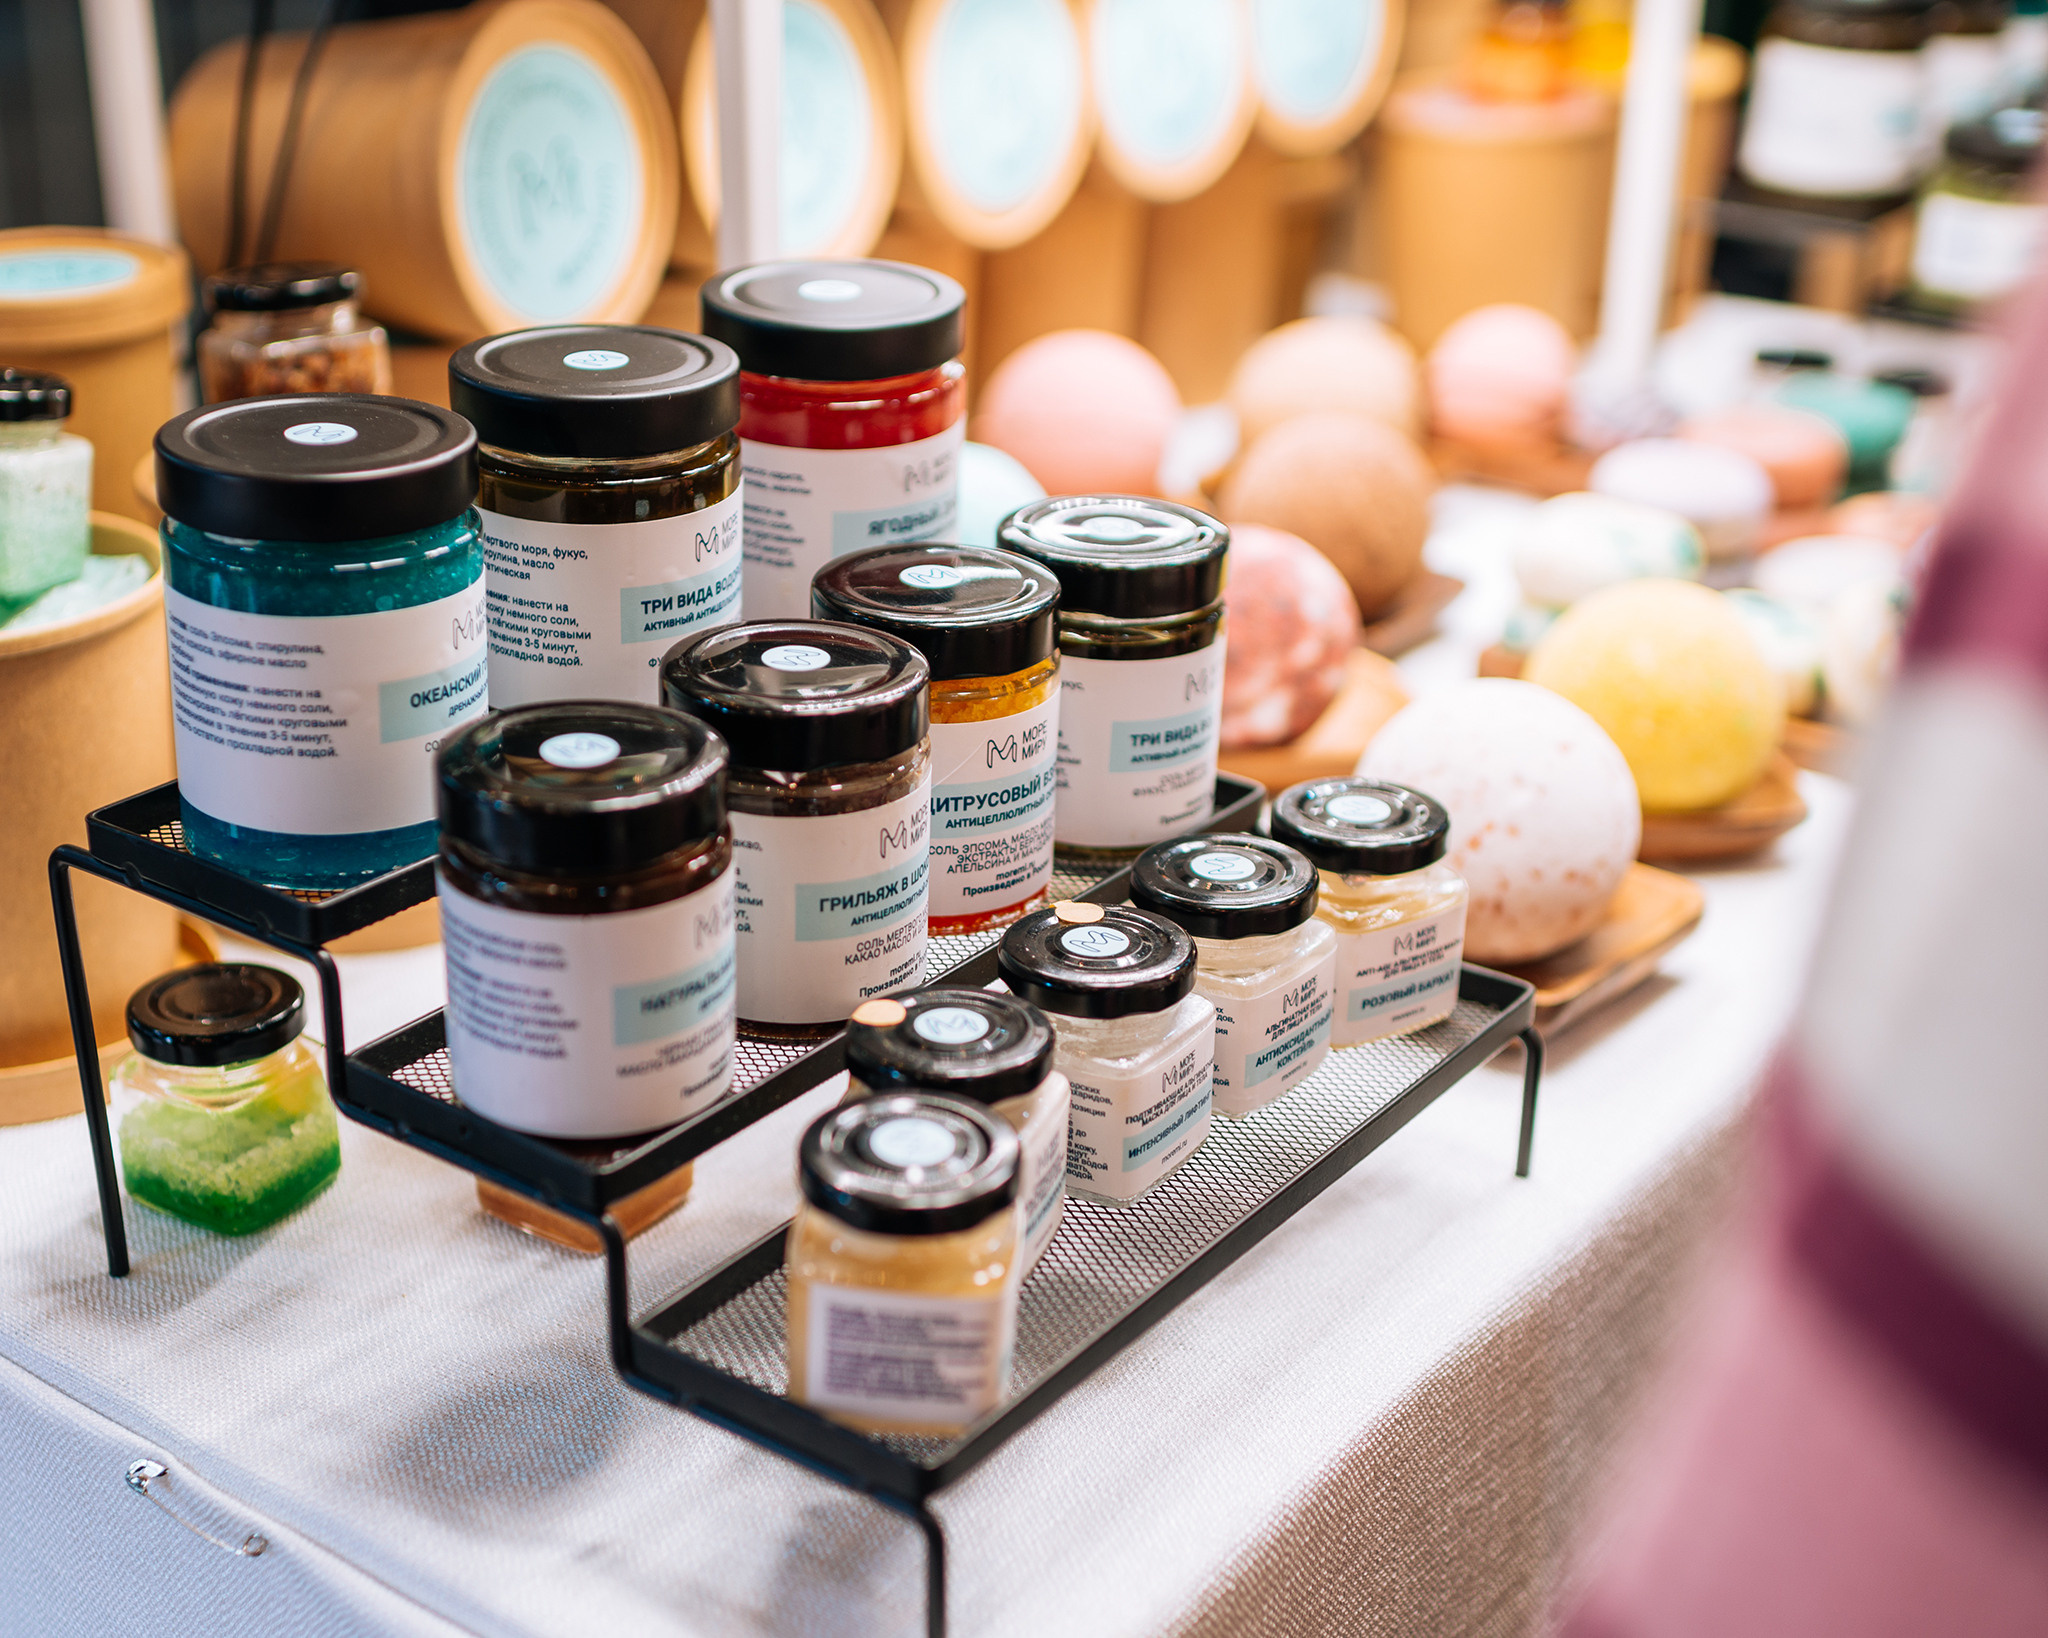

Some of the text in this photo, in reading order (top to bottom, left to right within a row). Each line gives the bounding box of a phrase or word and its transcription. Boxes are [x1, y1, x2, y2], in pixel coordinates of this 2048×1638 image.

[521, 544, 551, 558] моря,
[552, 546, 589, 561] фукус,
[522, 558, 555, 570] масло
[512, 596, 552, 611] нанести
[555, 604, 569, 613] на
[641, 597, 673, 615] ТРИ
[677, 585, 714, 609] ВИДА
[506, 609, 548, 623] немного
[550, 617, 579, 627] соли,
[643, 612, 695, 632] АКТИВНЫЙ
[489, 628, 578, 654] течение 3-5 минут,
[531, 626, 592, 641] круговыми
[267, 657, 307, 669] масло
[490, 642, 583, 667] прохладной водой.
[253, 686, 303, 699] нанести
[305, 690, 322, 699] на
[410, 663, 482, 708] ОКЕАНСКИЙ
[246, 702, 297, 713] немного
[299, 704, 334, 715] соли,
[225, 723, 267, 739] течение
[269, 730, 288, 741] 3-5
[290, 734, 333, 745] минут,
[277, 718, 348, 730] круговыми
[1022, 720, 1048, 744] МОРЕ
[1130, 724, 1198, 746] ТРИ ВИДА
[226, 738, 294, 757] прохладной
[297, 747, 339, 759] водой.
[1022, 736, 1048, 760] МИРУ
[945, 793, 1046, 829] АНТИЦЕЛЛЮЛИТНЫЙ
[929, 844, 960, 855] СОЛЬ
[962, 838, 1009, 854] ЭПСОМА,
[1011, 824, 1040, 843] МАСЛО
[946, 852, 1020, 874] АПЕЛЬСИНА И
[957, 845, 1019, 864] ЭКСТРАКТЫ
[996, 860, 1036, 881] moremi.ru
[819, 881, 899, 912] ГРИЛЬЯЖ
[901, 877, 909, 891] В
[963, 875, 1026, 897] Произведено
[845, 948, 881, 965] КАКАО
[882, 933, 912, 955] МАСЛО
[856, 937, 885, 953] СОЛЬ
[890, 951, 921, 977] moremi.ru
[859, 966, 914, 998] Произведено
[1361, 968, 1454, 1010] РОЗОВЫЙ БАРХАТ
[1265, 990, 1328, 1036] АЛЬГИНАТНАЯ МАСКА
[1255, 1008, 1332, 1068] АНТИОКСИДАНТНЫЙ
[1271, 1026, 1285, 1042] ДЛЯ
[1286, 1017, 1303, 1033] ЛИЦА
[1180, 1049, 1196, 1070] МОРЕ
[1277, 1038, 1316, 1069] КОКТЕЙЛЬ
[1125, 1085, 1184, 1125] ПОДТЯГИВАЮЩАЯ
[1141, 1108, 1163, 1127] МАСКА
[1164, 1101, 1176, 1114] ДЛЯ
[1176, 1088, 1191, 1104] ЛИЦА
[1075, 1129, 1087, 1137] до
[1128, 1089, 1212, 1159] ИНТЕНСИВНЫЙ ЛИФТИНГ
[1161, 1139, 1188, 1165] moremi.ru
[1081, 1158, 1108, 1171] водой
